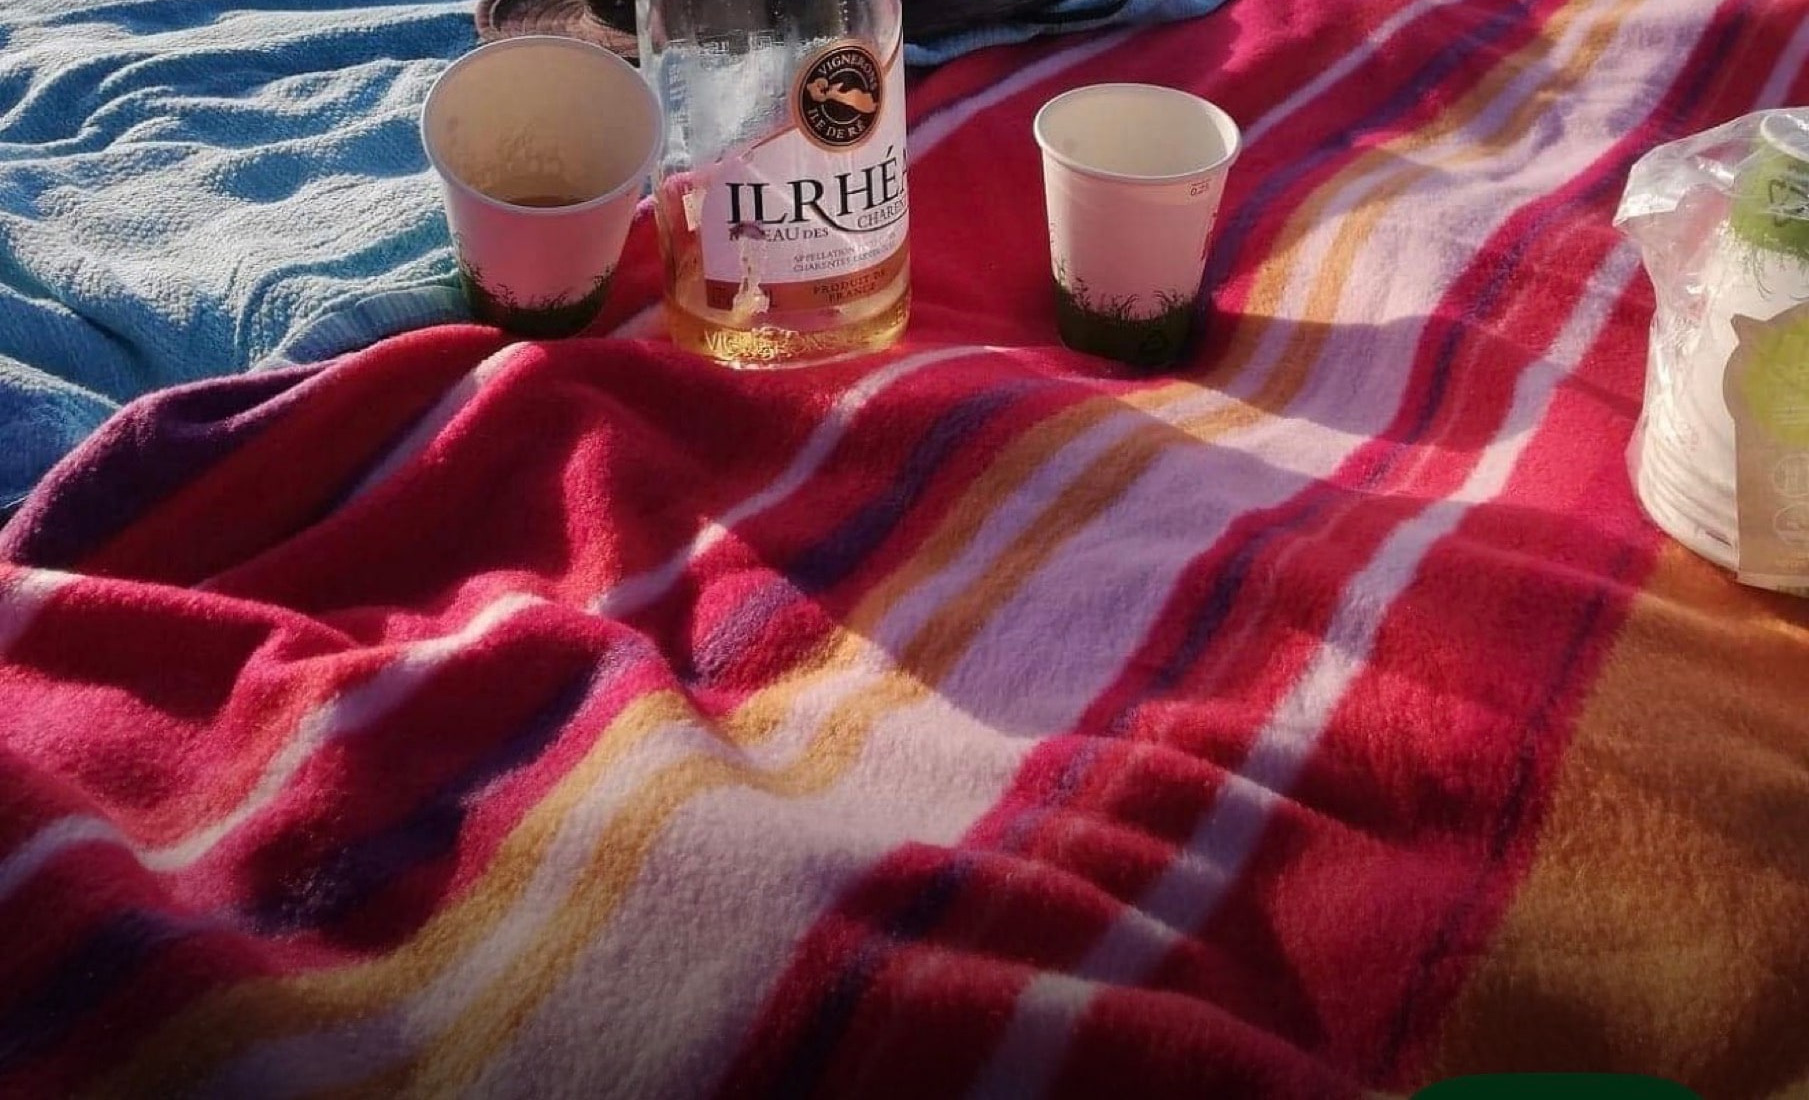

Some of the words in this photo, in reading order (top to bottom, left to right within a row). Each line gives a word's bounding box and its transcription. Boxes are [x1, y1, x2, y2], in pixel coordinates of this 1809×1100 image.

[817, 52, 879, 91] VIGNERONS
[826, 126, 845, 139] DE
[802, 227, 829, 240] DES
[813, 274, 870, 295] PRODUIT
